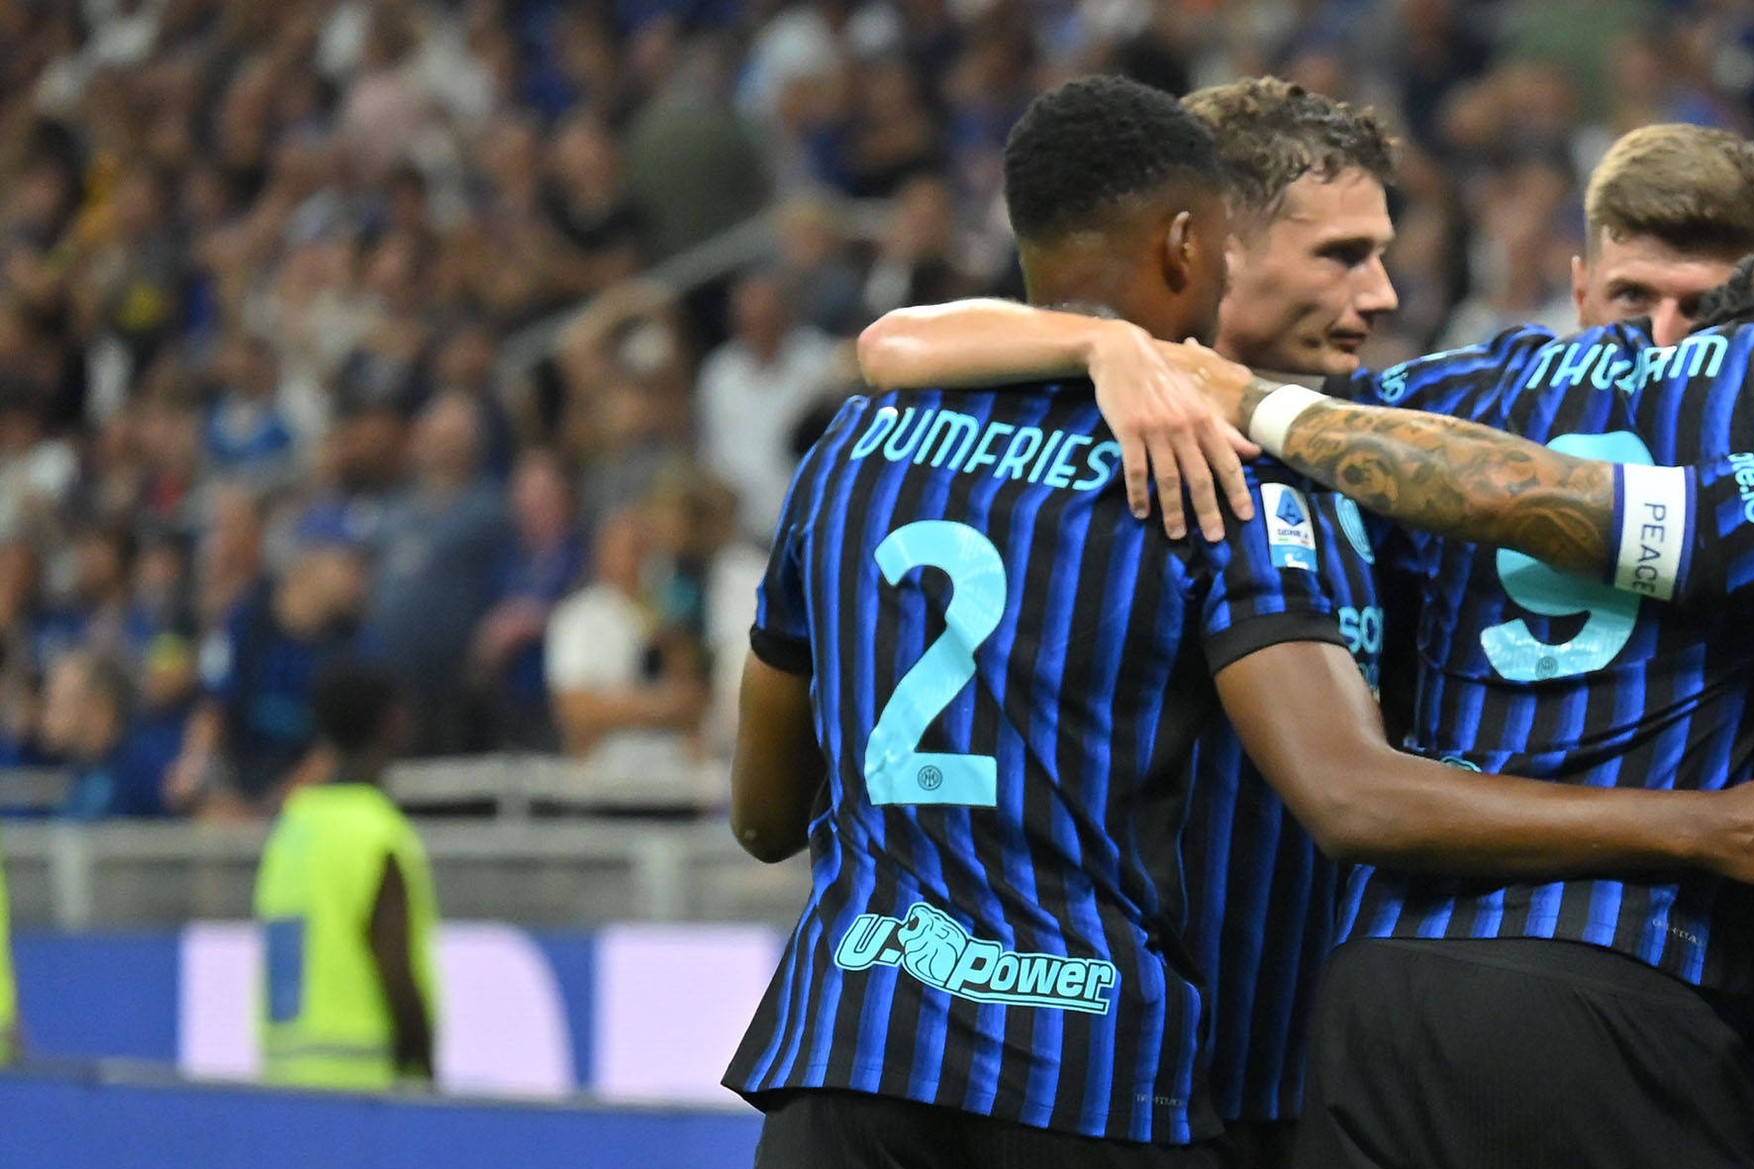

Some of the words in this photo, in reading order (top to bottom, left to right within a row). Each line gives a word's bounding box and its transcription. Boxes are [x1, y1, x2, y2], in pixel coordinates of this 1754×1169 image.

[850, 406, 1120, 491] DUMFRIES
[1481, 431, 1657, 681] 9
[1632, 503, 1666, 593] PEACE
[864, 519, 1007, 806] 2
